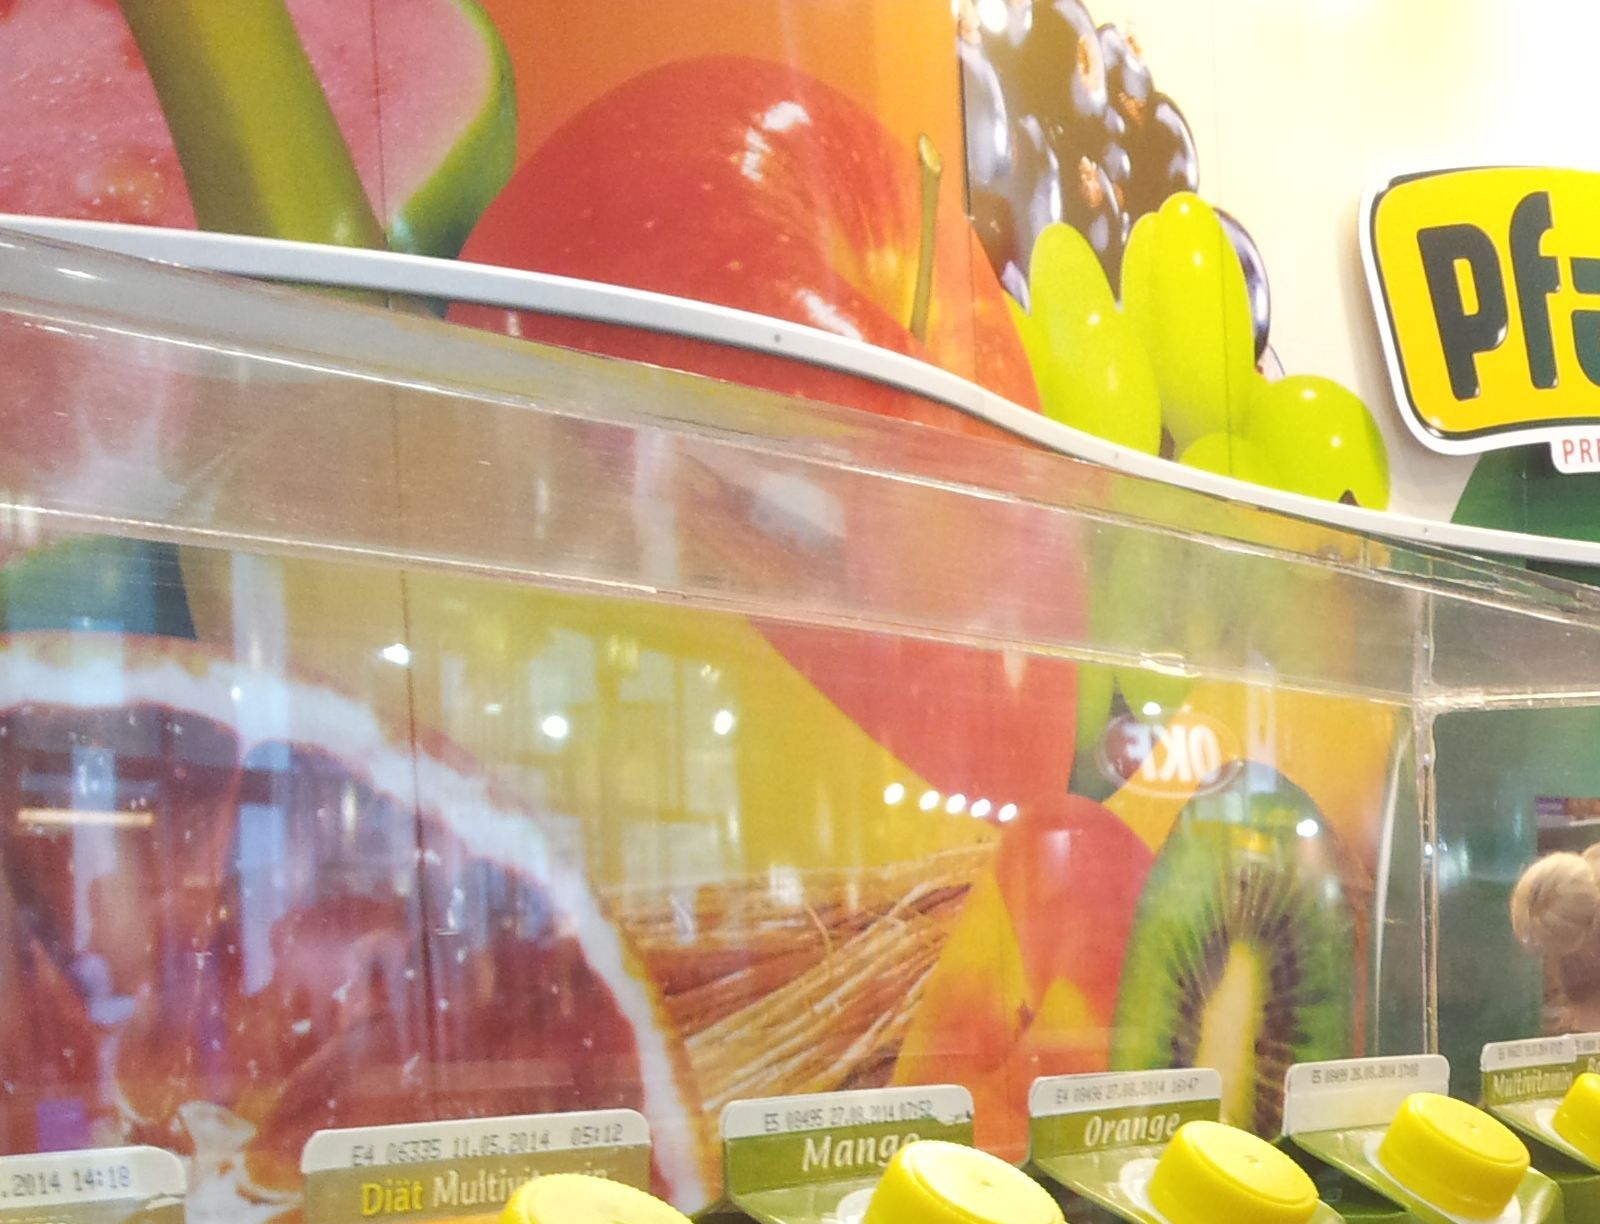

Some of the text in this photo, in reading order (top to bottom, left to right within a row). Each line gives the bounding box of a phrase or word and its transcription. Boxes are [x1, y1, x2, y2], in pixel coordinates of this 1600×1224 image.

[351, 1144, 376, 1168] E4
[452, 1129, 551, 1158] 11.05.2014
[570, 1122, 625, 1146] 05:12
[1084, 1113, 1182, 1148] Orange
[360, 1178, 425, 1216] Diät
